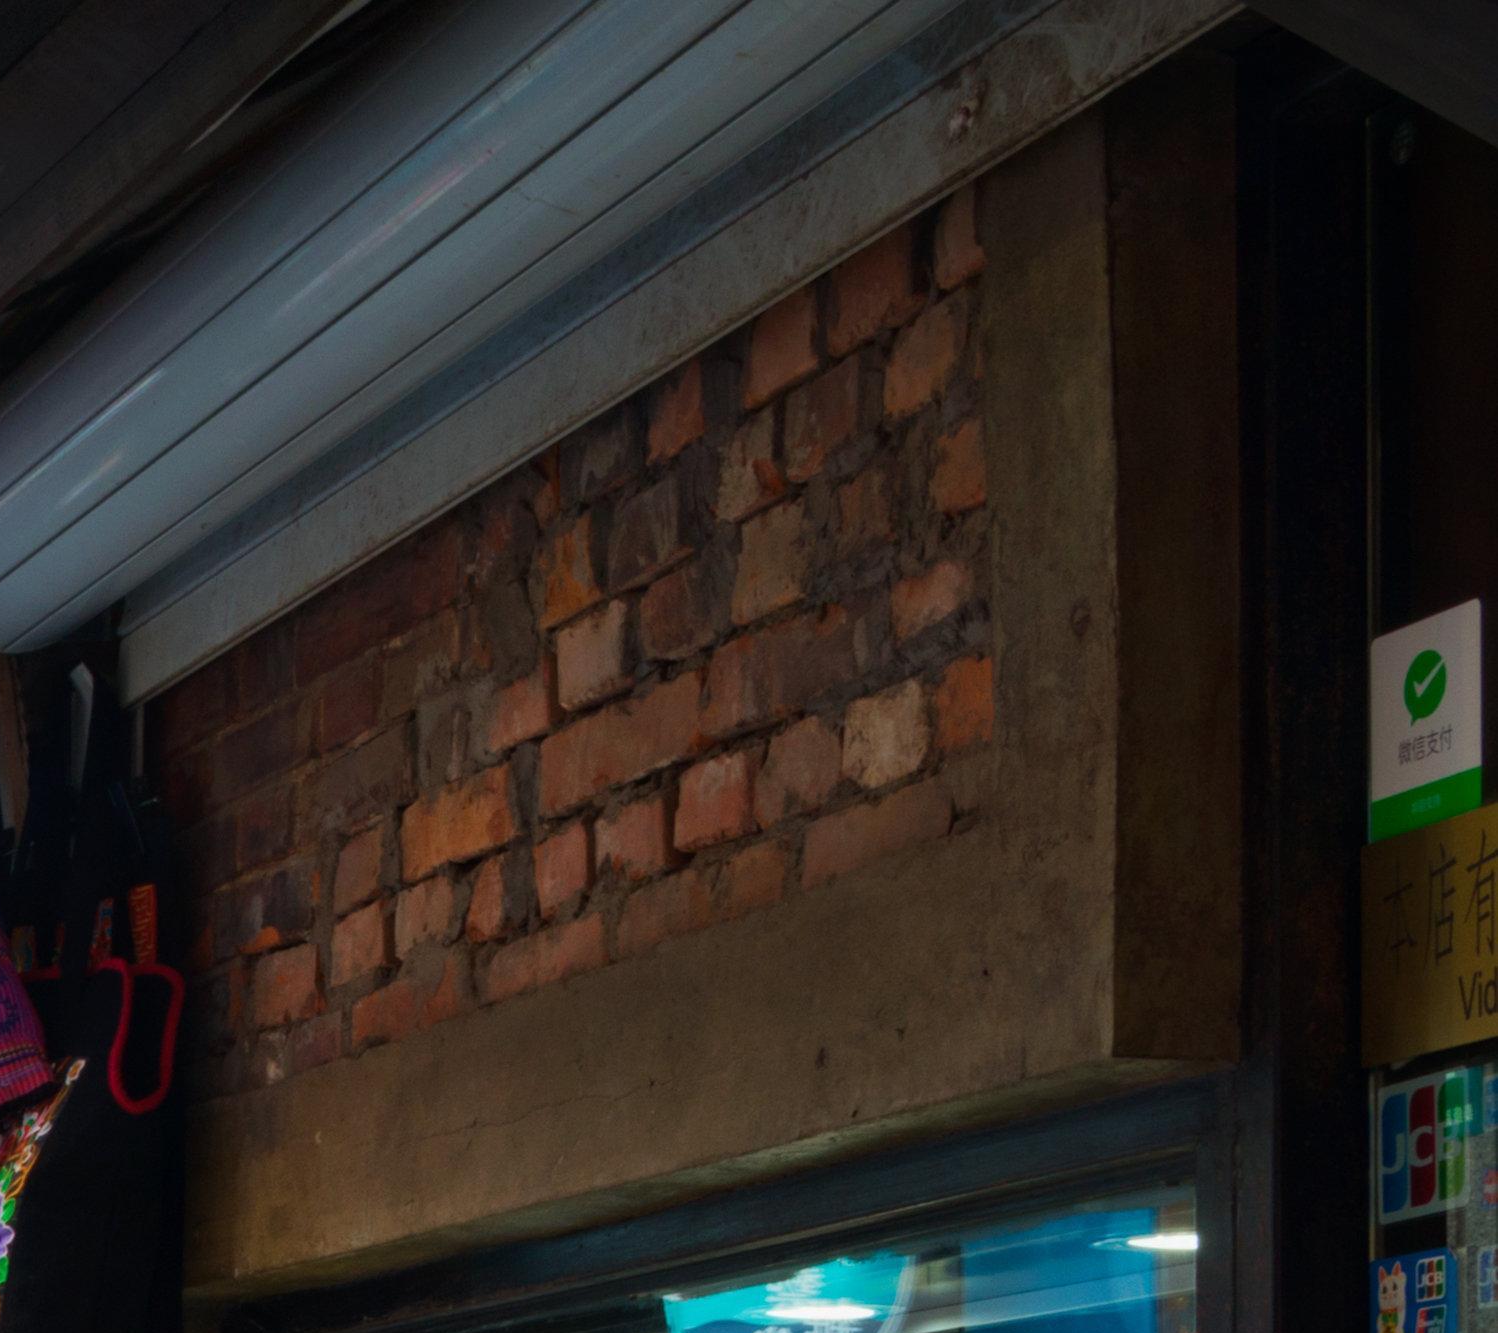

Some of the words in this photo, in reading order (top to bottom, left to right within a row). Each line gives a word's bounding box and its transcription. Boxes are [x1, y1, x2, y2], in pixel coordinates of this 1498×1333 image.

[1398, 724, 1454, 765] 微信支付
[1381, 1121, 1461, 1175] JCB
